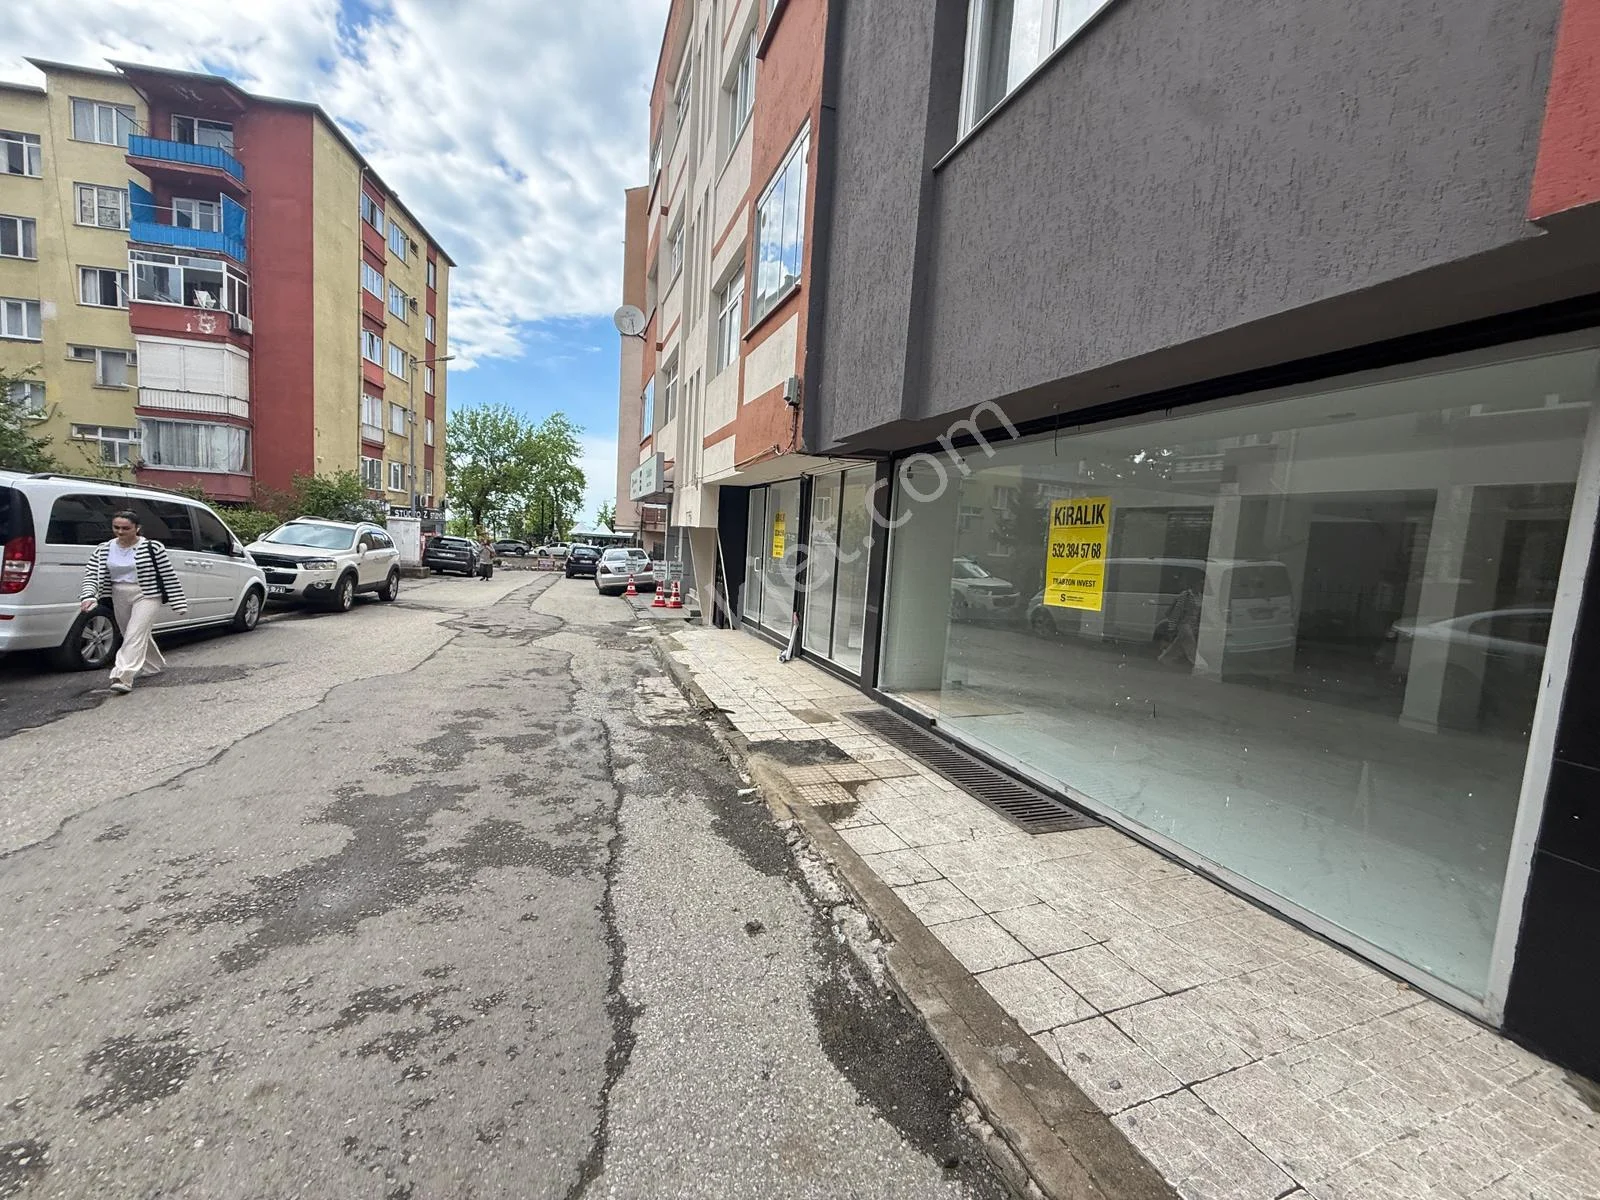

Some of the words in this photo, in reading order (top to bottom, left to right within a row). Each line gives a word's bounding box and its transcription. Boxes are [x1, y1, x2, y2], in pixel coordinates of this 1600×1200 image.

[1052, 543, 1065, 558] 532
[1065, 543, 1079, 558] 384
[1081, 543, 1091, 558] 57
[1091, 543, 1102, 559] 68
[1077, 579, 1096, 588] INVEST
